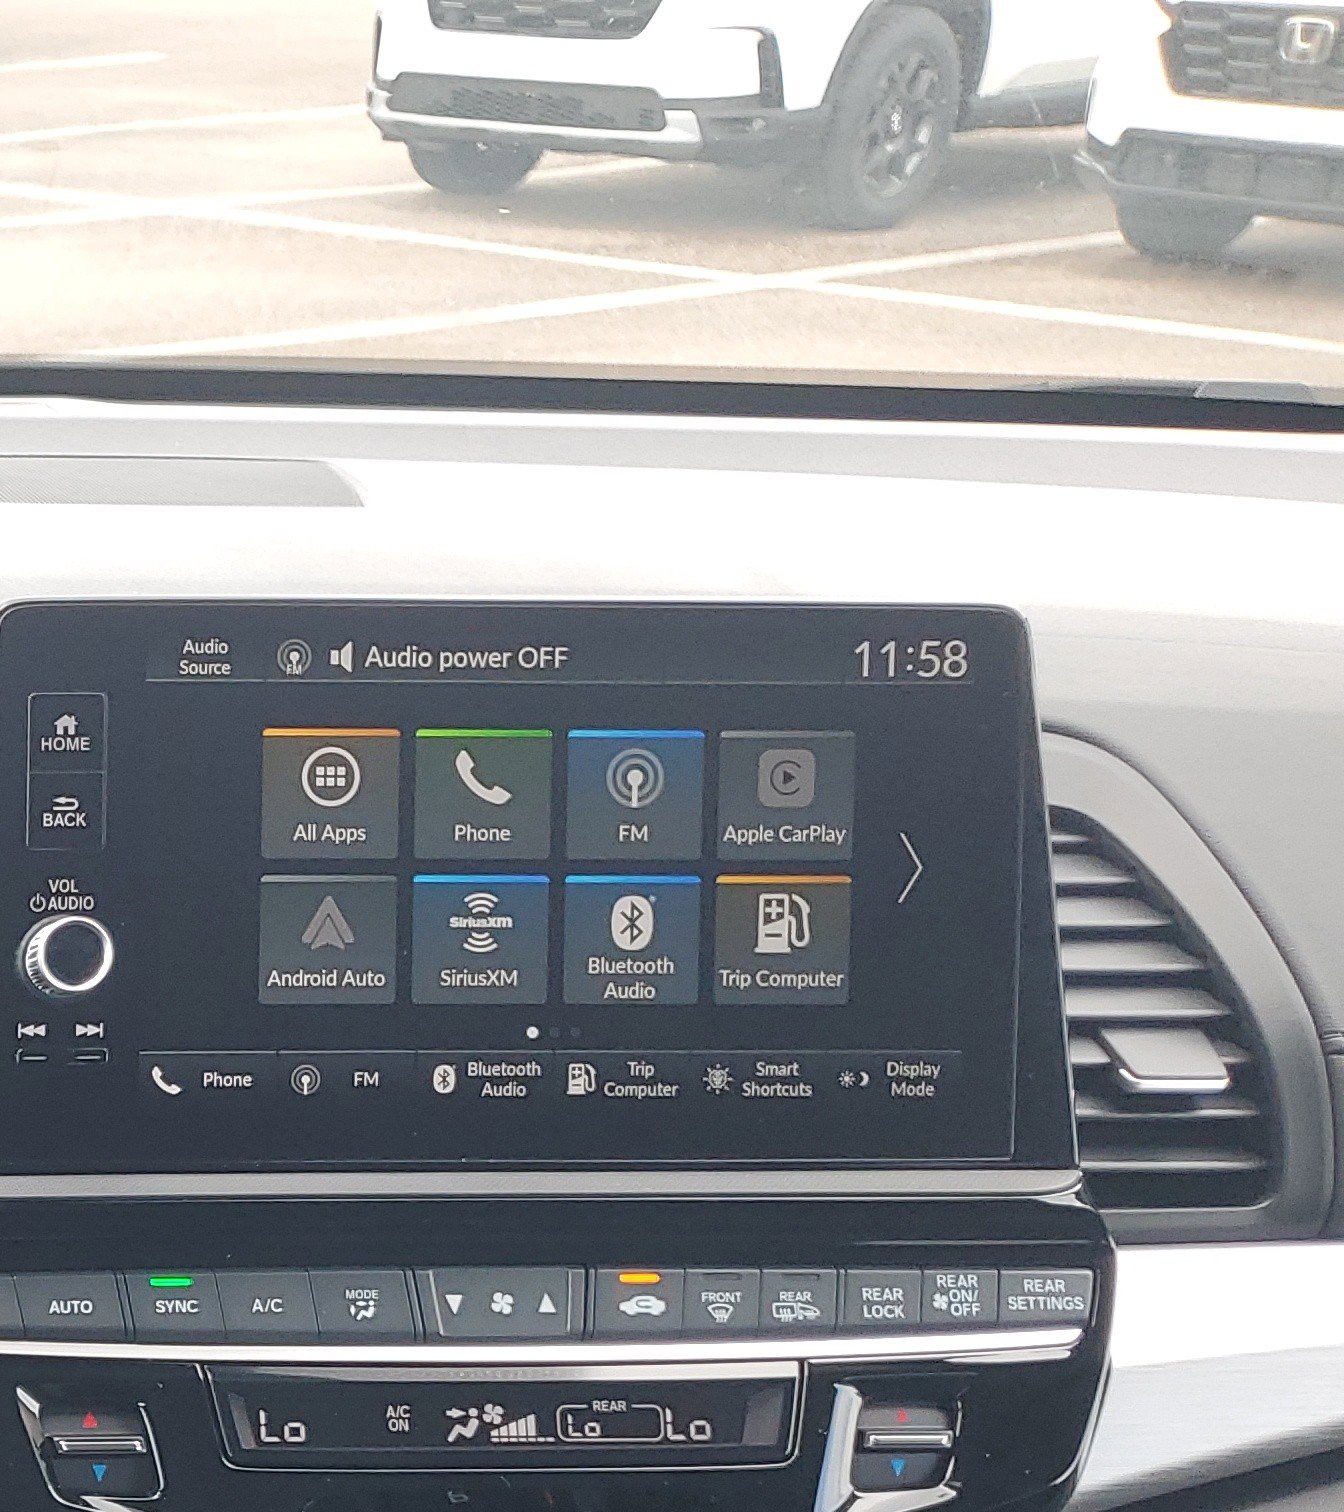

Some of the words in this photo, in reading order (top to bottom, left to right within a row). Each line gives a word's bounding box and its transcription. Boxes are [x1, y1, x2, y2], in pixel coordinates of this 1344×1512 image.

[182, 638, 229, 656] Audio
[178, 659, 232, 676] Source
[364, 646, 432, 669] Audio
[439, 650, 511, 672] power
[517, 646, 570, 669] OFF
[852, 639, 970, 679] 11:58
[40, 737, 91, 752] HOME
[42, 813, 87, 828] BACK
[293, 824, 317, 842] All
[321, 825, 367, 846] Apps
[453, 823, 512, 843] Phone
[618, 824, 649, 842] FM
[723, 824, 774, 847] Apple
[779, 824, 847, 846] CarPlay
[48, 879, 79, 894] VOL
[47, 896, 95, 911] AUDIO
[587, 956, 675, 976] Bluetooth
[267, 969, 336, 988] Android
[341, 969, 386, 988] Auto
[439, 968, 519, 988] SiriusXM
[718, 969, 752, 993] Trip
[755, 969, 845, 992] Computer
[603, 981, 656, 1000] Audio
[467, 1061, 542, 1078] Bluetooth
[626, 1061, 656, 1080] Trip
[755, 1061, 799, 1077] Smart
[886, 1061, 941, 1081] Display
[203, 1071, 253, 1089] Phone
[353, 1072, 380, 1088] FM
[480, 1081, 527, 1098] Audio
[603, 1081, 679, 1099] Computer
[741, 1081, 813, 1097] Shortcuts
[890, 1081, 935, 1097] Mode
[936, 1273, 979, 1289] REAR
[1023, 1278, 1067, 1294] REAR
[344, 1287, 380, 1300] MODE
[701, 1291, 743, 1304] FRONT
[778, 1290, 812, 1303] REAR
[861, 1286, 904, 1304] REAR
[948, 1287, 980, 1303] ON/
[48, 1299, 93, 1315] AUTO
[154, 1299, 200, 1315] SYNC
[251, 1297, 284, 1315] A/C
[862, 1302, 906, 1320] LOCK
[950, 1301, 981, 1317] OFF
[1007, 1293, 1085, 1312] SETTINGS
[385, 1404, 412, 1419] A/C
[592, 1400, 628, 1412] REAR
[259, 1408, 307, 1445] Lo
[387, 1418, 411, 1433] ON
[566, 1412, 602, 1438] Lo
[665, 1407, 712, 1443] Lo
